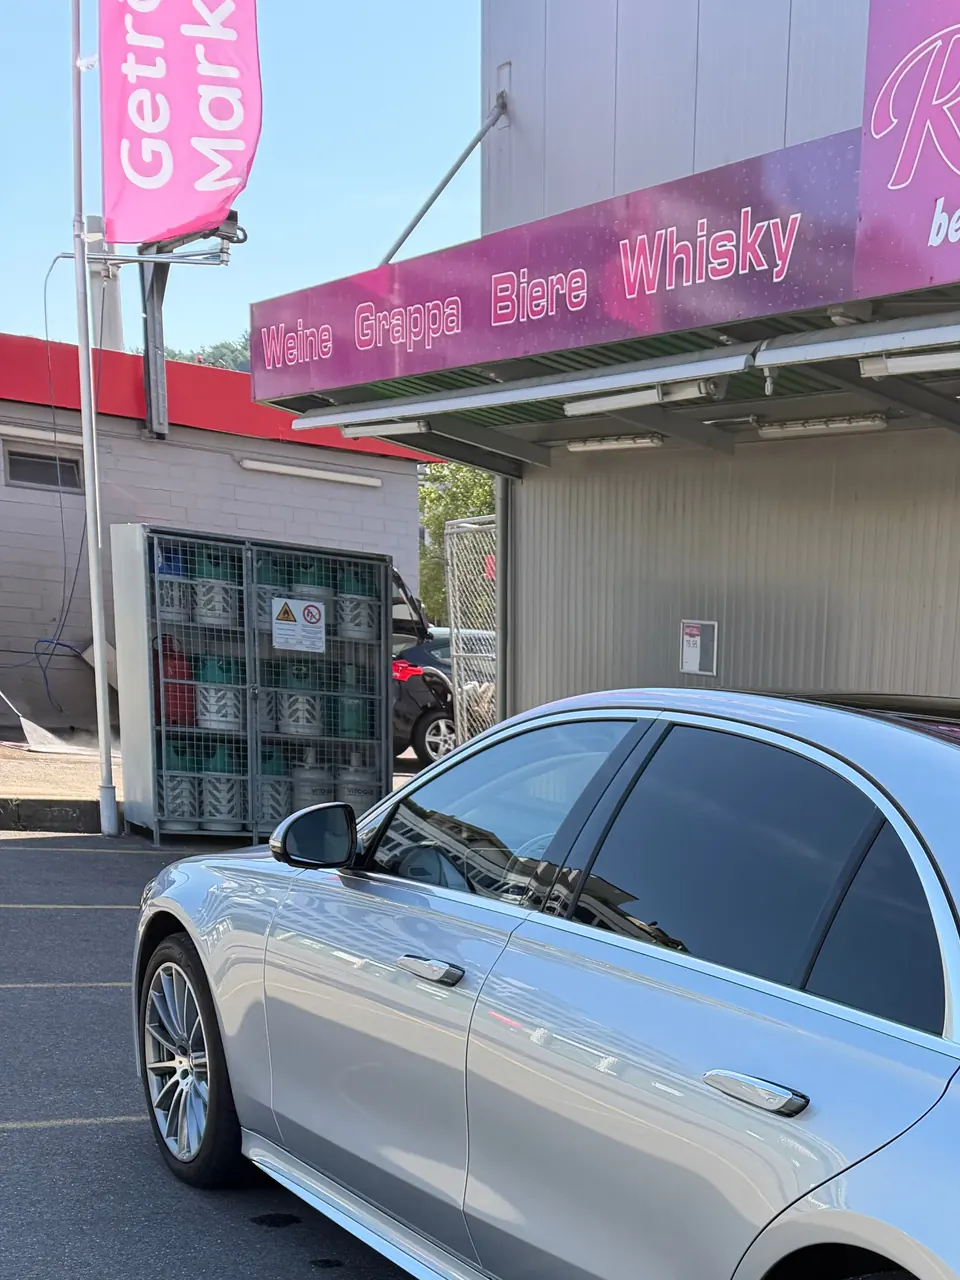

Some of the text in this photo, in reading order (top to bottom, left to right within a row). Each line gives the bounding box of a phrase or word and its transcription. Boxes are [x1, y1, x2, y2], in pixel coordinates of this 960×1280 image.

[261, 207, 801, 370] Weine Grappa Biere Whisky
